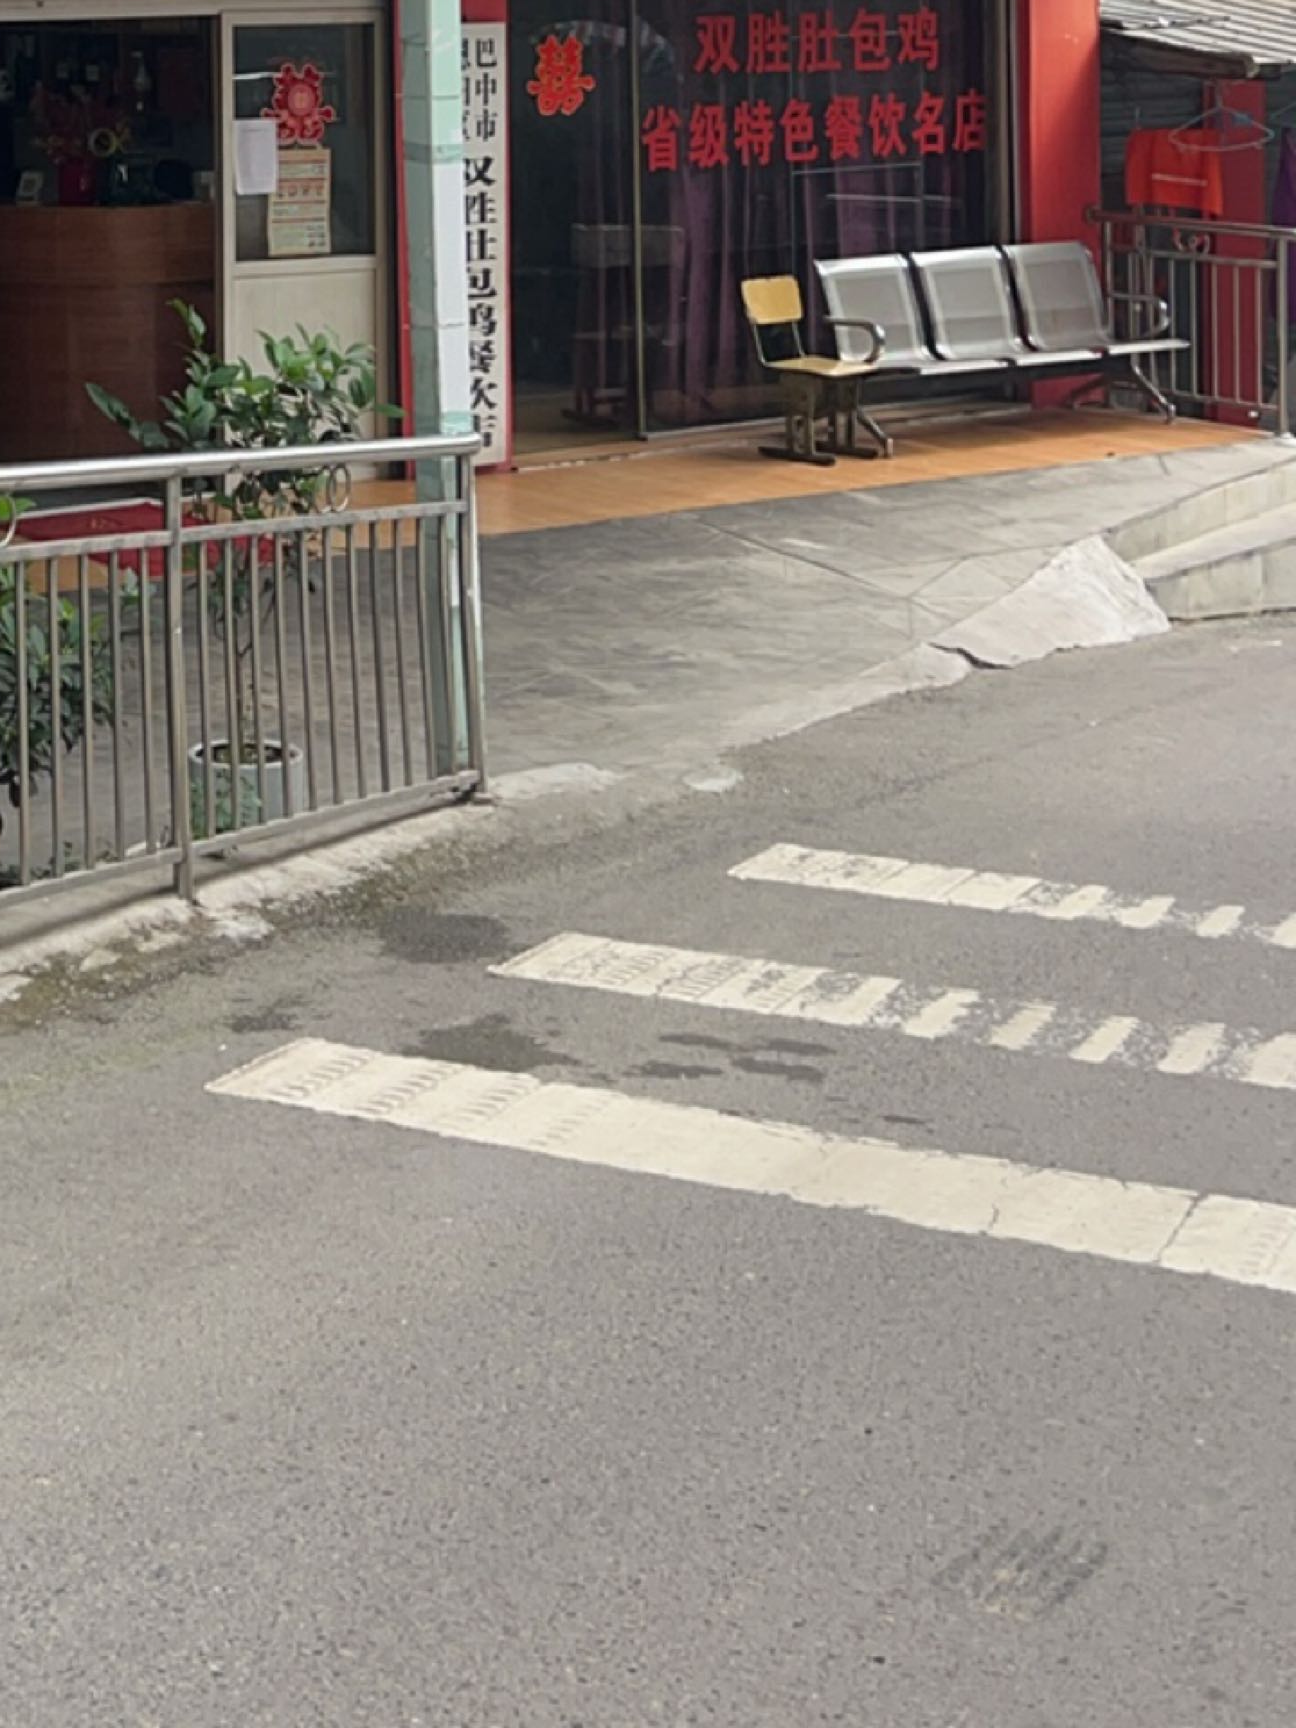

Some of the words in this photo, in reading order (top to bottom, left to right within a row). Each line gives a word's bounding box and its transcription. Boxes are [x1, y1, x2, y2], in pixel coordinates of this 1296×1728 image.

[694, 6, 940, 75] 双胜肚包鸡
[641, 88, 988, 172] 省级特色餐饮名店
